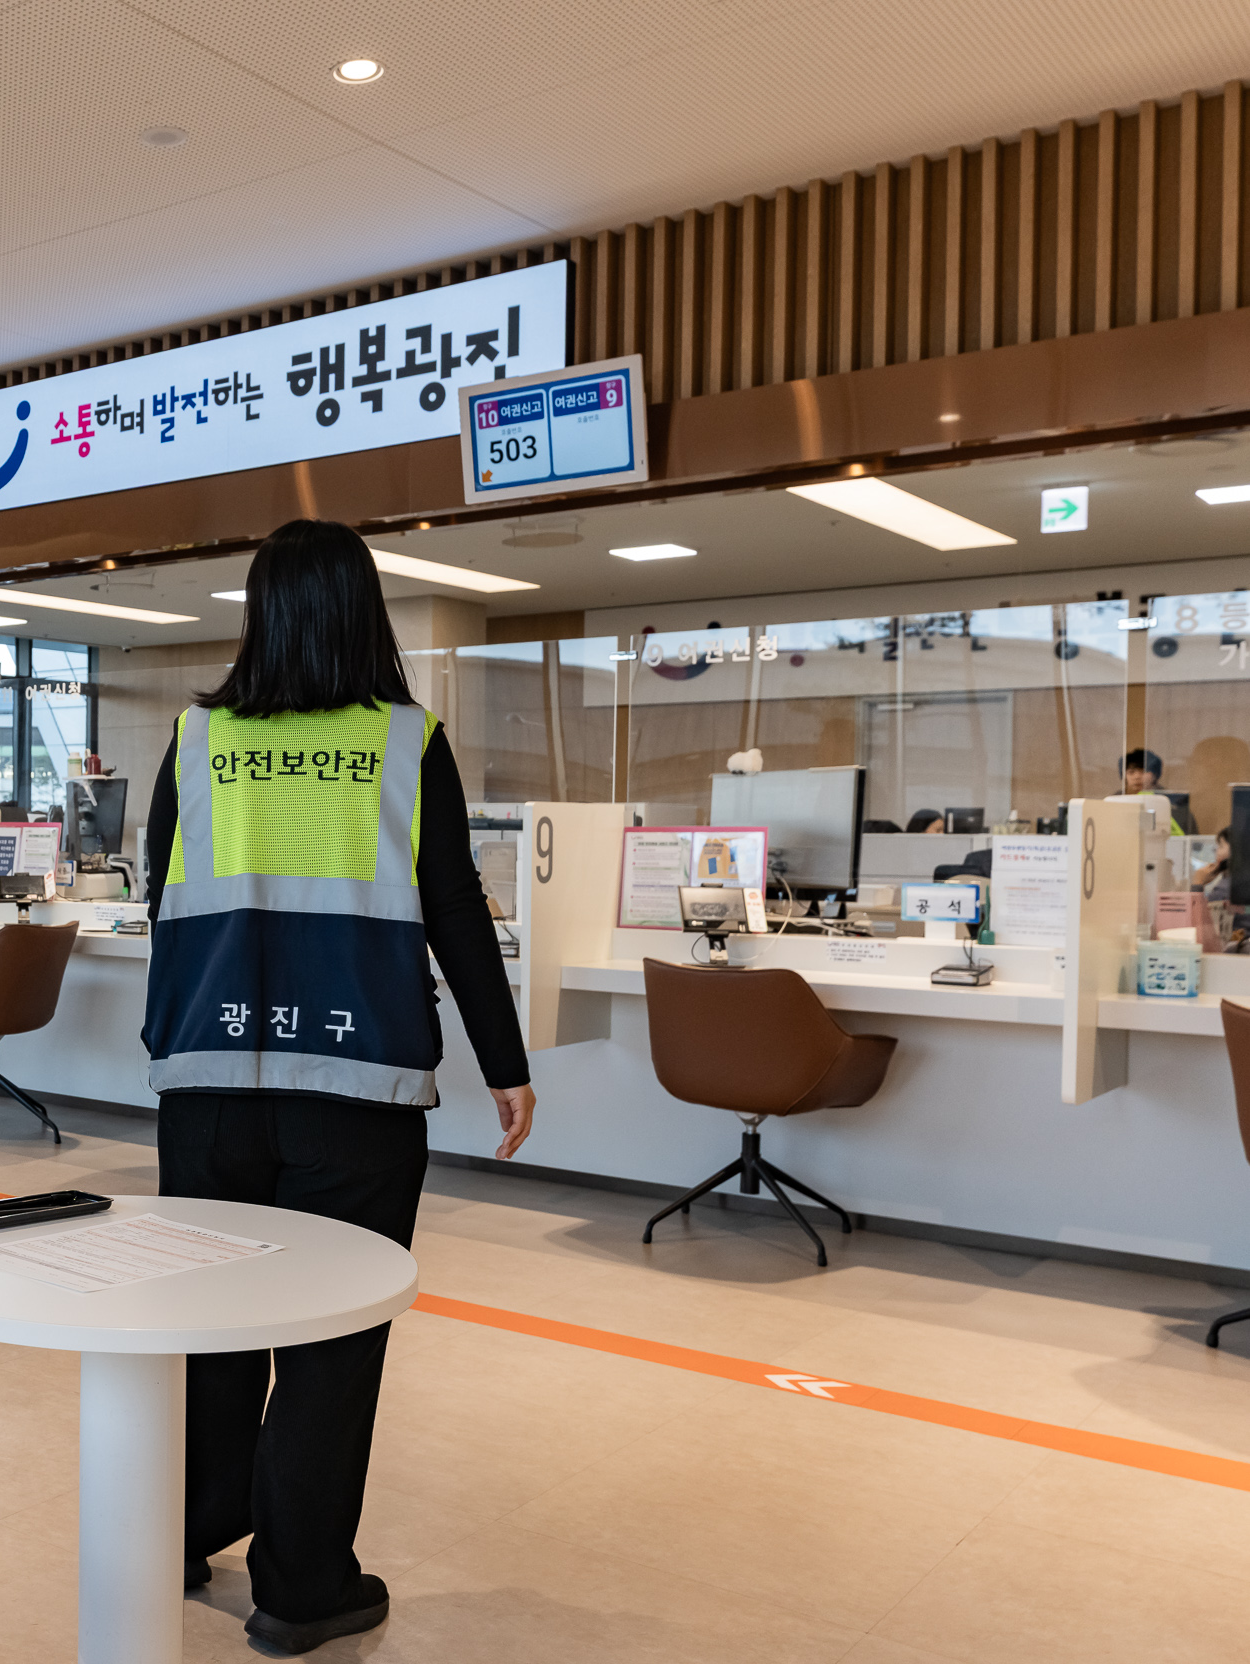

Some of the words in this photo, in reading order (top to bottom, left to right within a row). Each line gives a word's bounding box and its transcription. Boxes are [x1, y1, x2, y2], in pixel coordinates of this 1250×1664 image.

[479, 411, 498, 427] 10
[501, 400, 542, 418] 여권신고
[554, 391, 598, 409] 여권신고
[606, 390, 617, 407] 9
[51, 394, 144, 458] 소통하며
[152, 371, 264, 443] 발전하는
[490, 435, 537, 464] 503
[1175, 604, 1198, 633] 8
[646, 643, 663, 667] 9
[678, 635, 779, 664] 여권신청
[25, 682, 82, 700] 여권신청
[211, 750, 380, 784] 안전보안관
[536, 816, 553, 884] 9
[1083, 816, 1095, 900] 8
[916, 899, 930, 914] 공
[948, 900, 961, 915] 석
